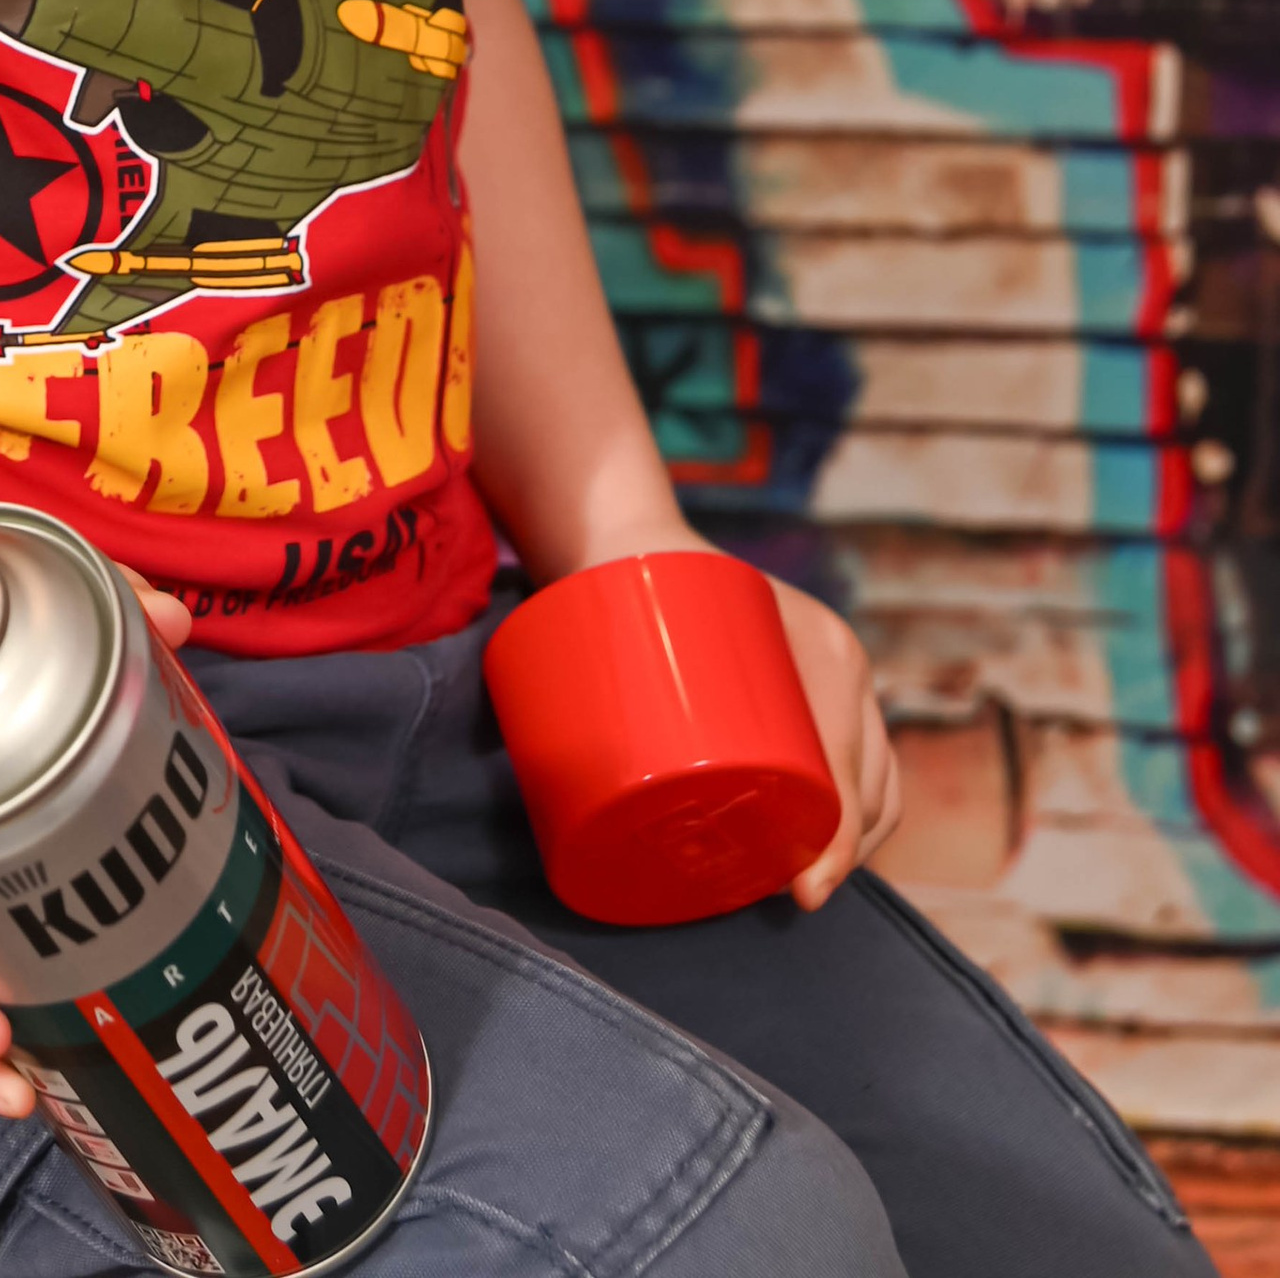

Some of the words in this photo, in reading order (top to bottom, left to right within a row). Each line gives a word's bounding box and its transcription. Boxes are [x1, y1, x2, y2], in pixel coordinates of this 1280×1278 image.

[221, 588, 260, 617] OF
[8, 730, 210, 959] KUDO
[154, 1001, 353, 1244] ЭМАЛЬ
[230, 964, 333, 1109] ГЛЯНЦЕВАЯ
